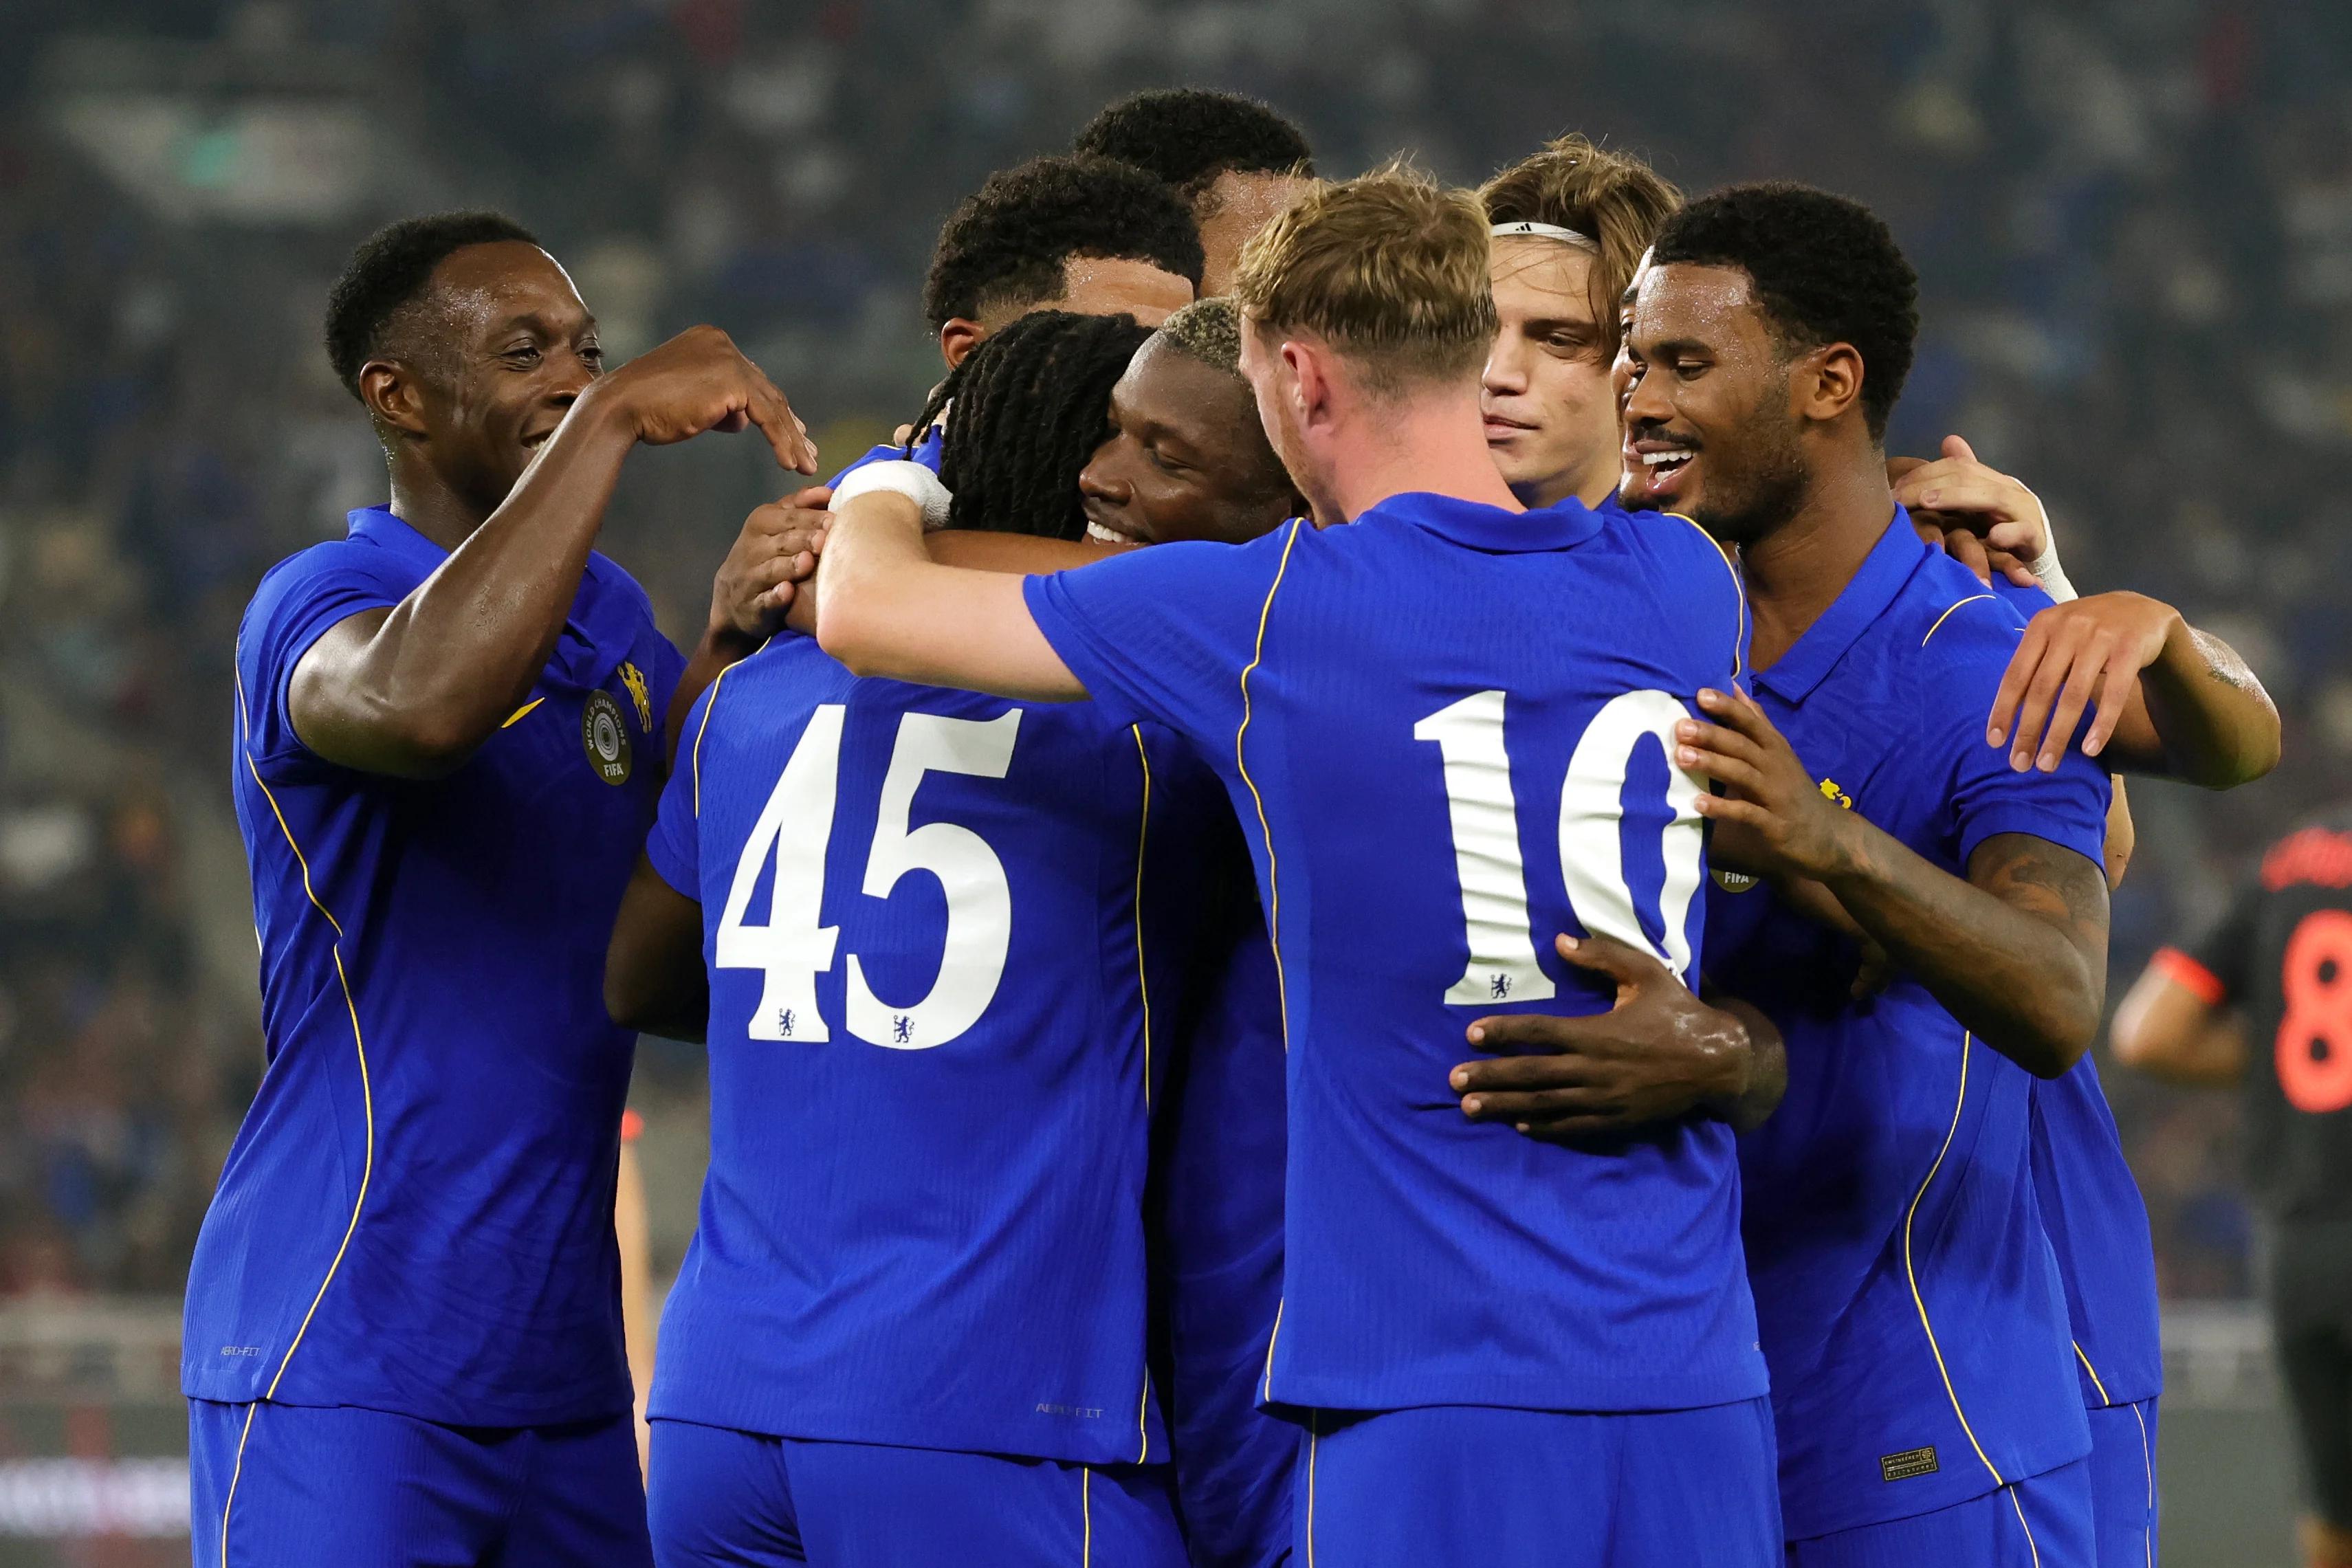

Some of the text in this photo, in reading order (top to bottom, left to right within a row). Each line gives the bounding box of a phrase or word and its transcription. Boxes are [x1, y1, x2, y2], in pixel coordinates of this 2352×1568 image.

[586, 699, 626, 749] WORLD CHAMPIONS
[604, 763, 624, 777] FIFA
[1414, 689, 1710, 1005] 10
[716, 704, 1023, 1050] 45
[1724, 872, 1749, 884] FIFA
